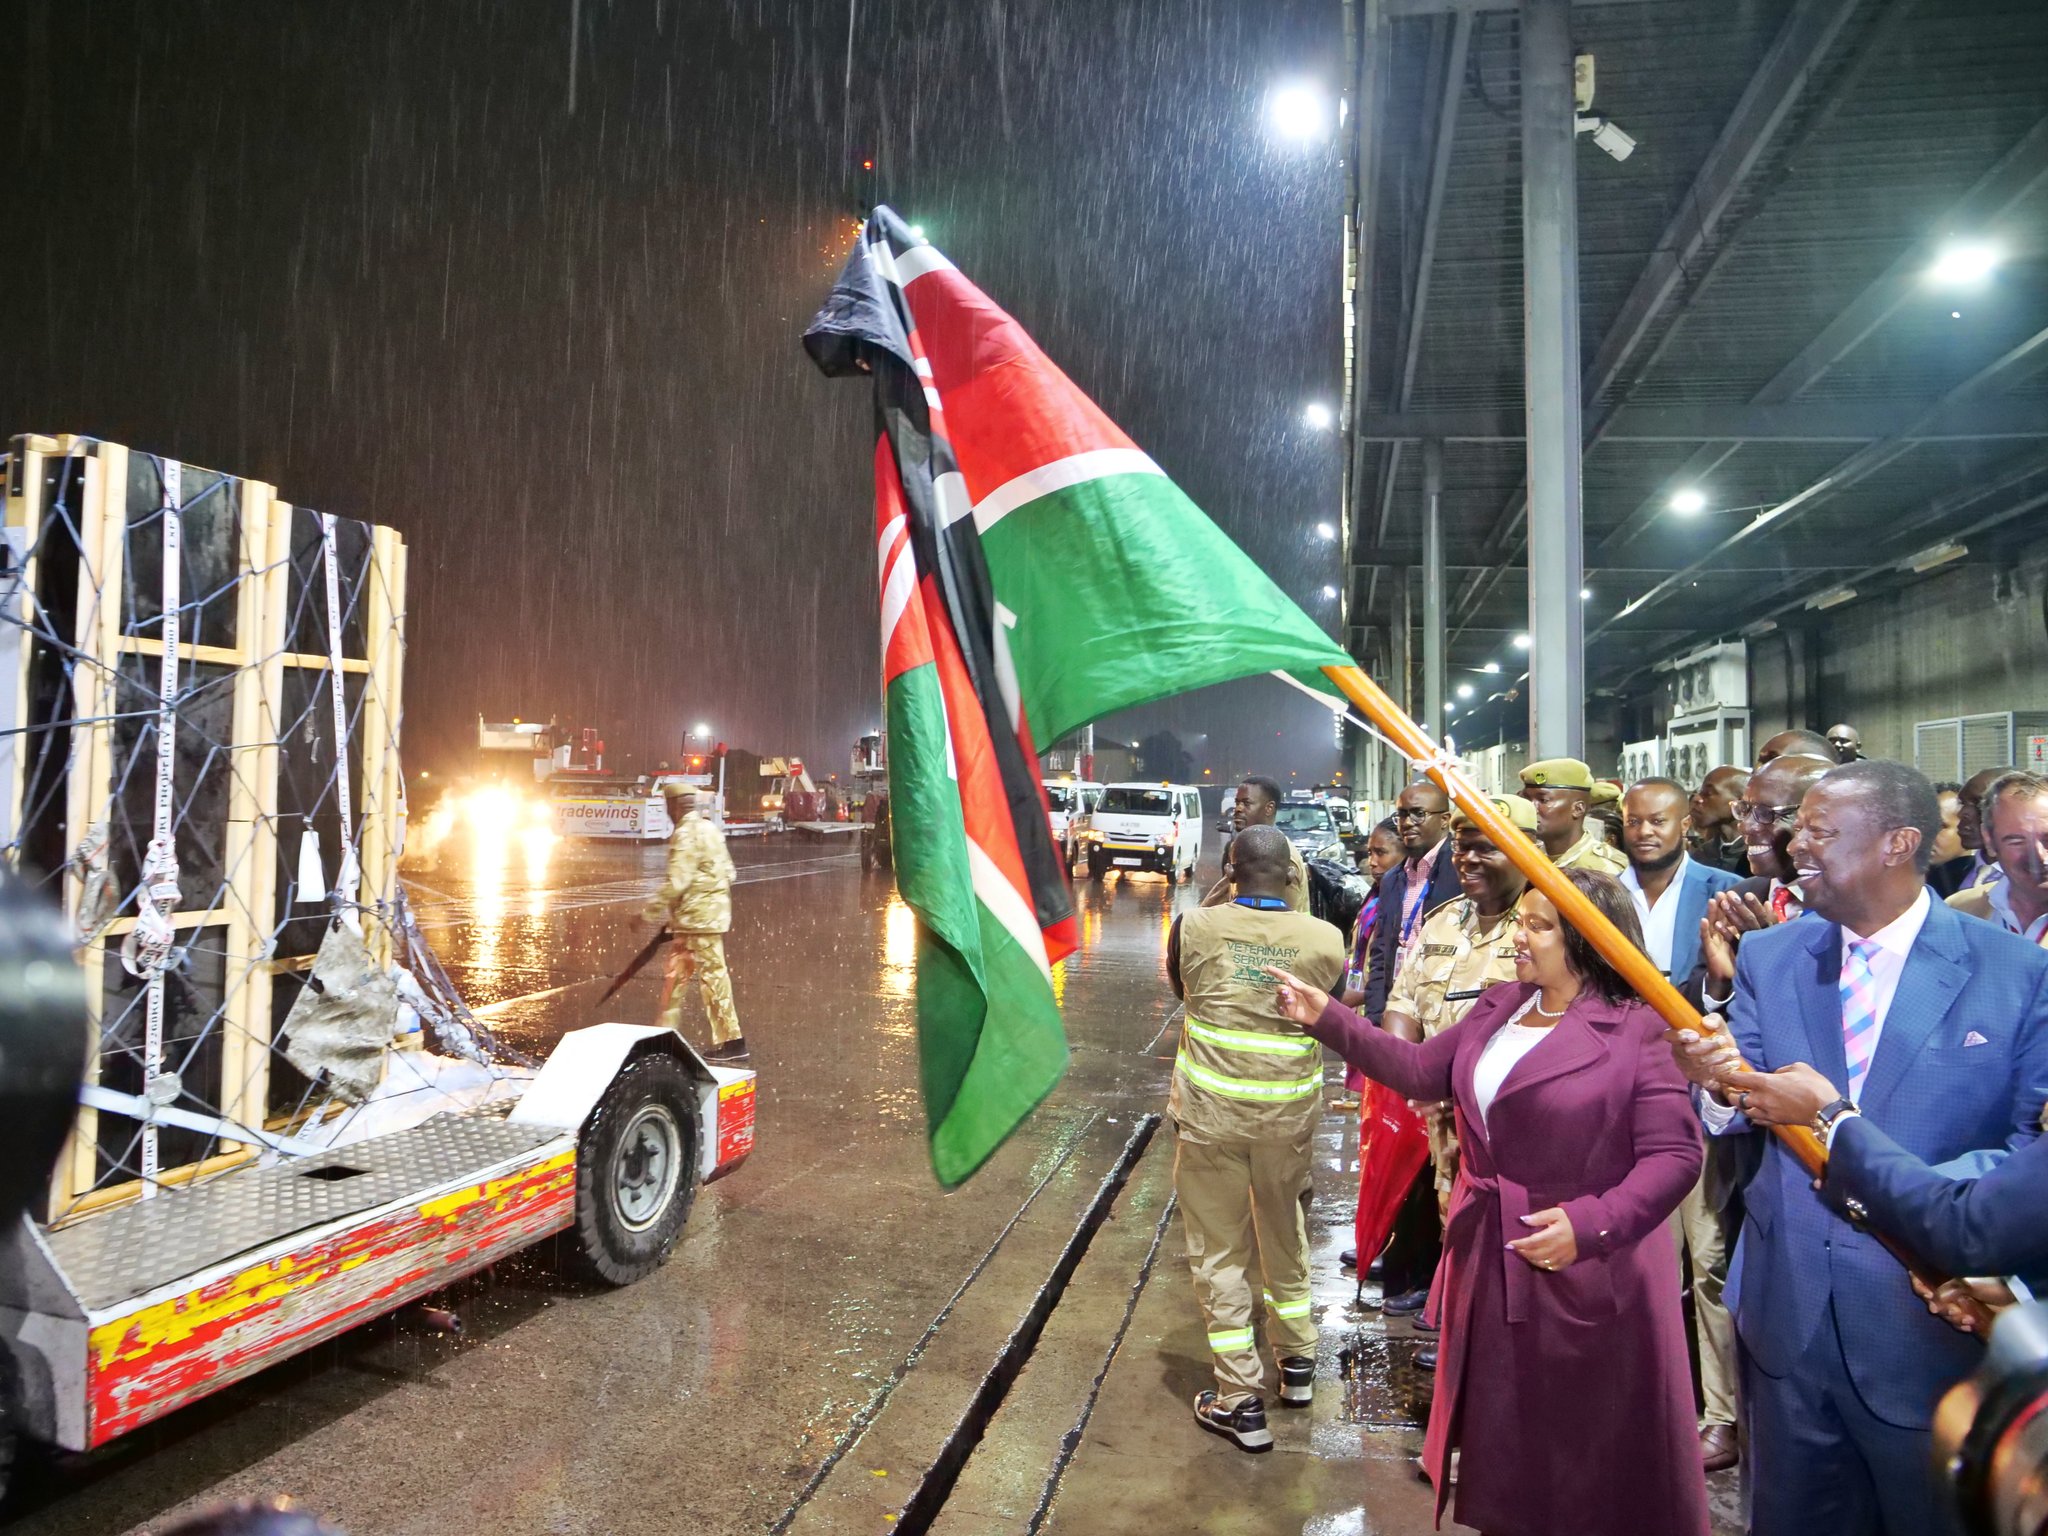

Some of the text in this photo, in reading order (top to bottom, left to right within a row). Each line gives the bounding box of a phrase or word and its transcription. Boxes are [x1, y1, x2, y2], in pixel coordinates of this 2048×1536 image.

[160, 731, 171, 809] PROPERTY
[166, 628, 176, 660] 5000
[557, 804, 639, 819] tradewinds
[1226, 941, 1300, 958] VETERINARY
[1232, 953, 1292, 970] SERVICES
[150, 992, 160, 1047] 2268KG
